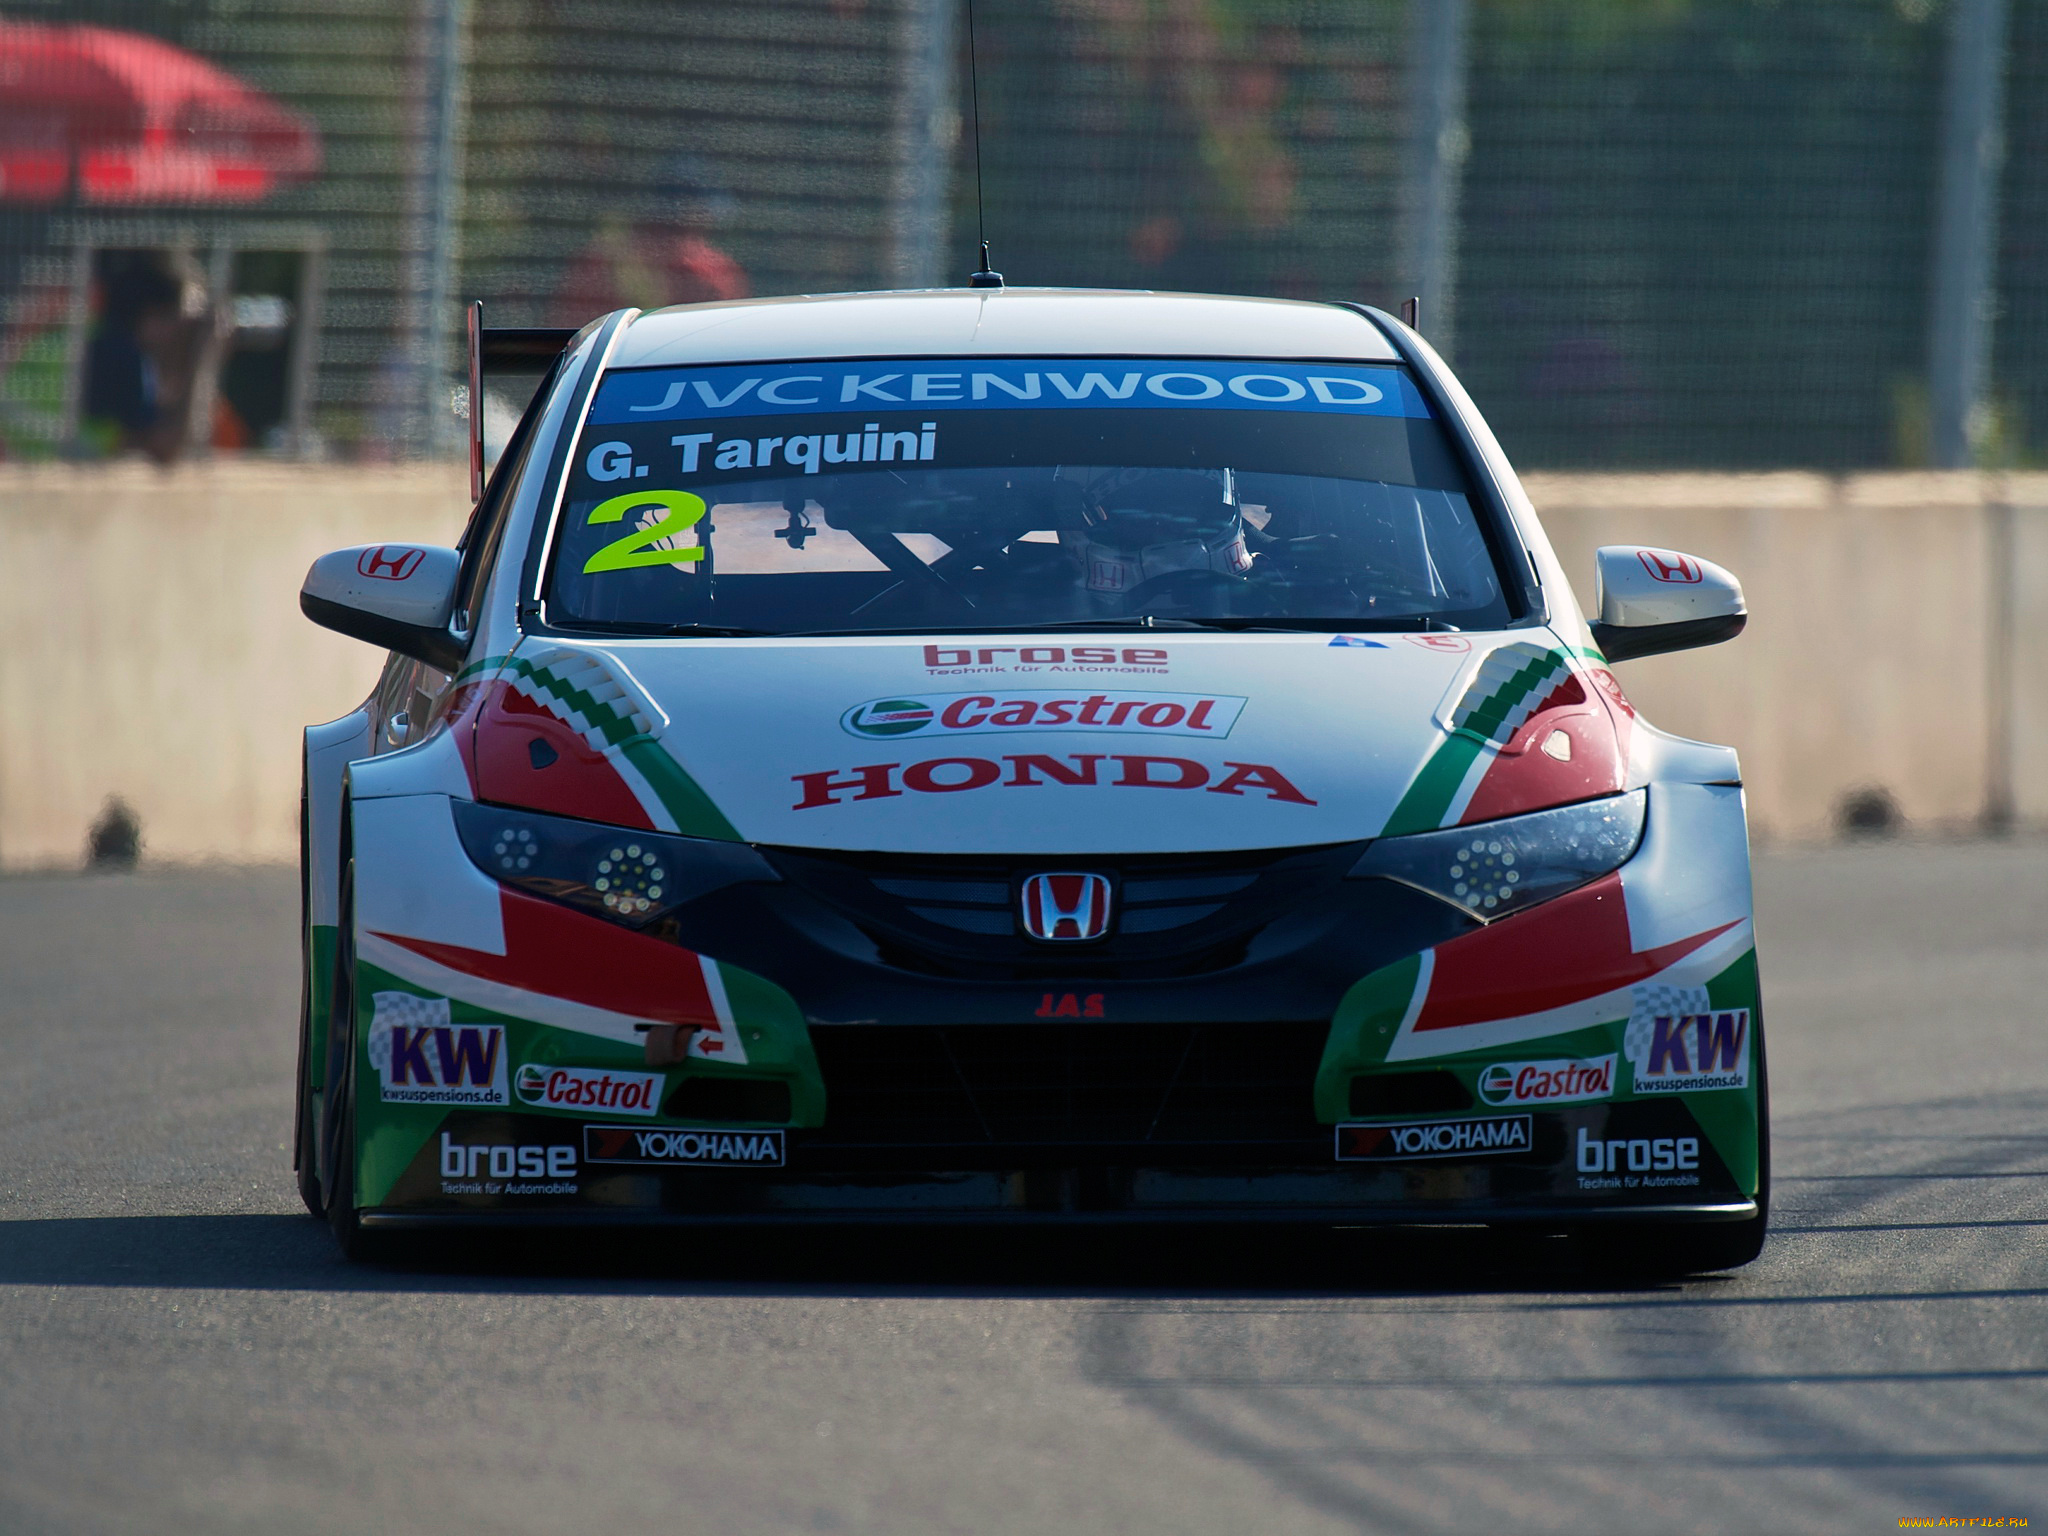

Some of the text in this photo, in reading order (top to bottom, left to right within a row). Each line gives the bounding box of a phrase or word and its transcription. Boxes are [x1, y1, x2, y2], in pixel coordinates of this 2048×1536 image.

[585, 422, 937, 482] G. Tarquini
[583, 489, 706, 574] 2
[923, 645, 1168, 667] brose
[925, 664, 1169, 676] Technik für Automobile
[940, 695, 1212, 731] Castrol
[791, 754, 1318, 811] HONDA
[1035, 993, 1105, 1018] JAS
[391, 1026, 501, 1088] KW
[1646, 1011, 1747, 1076] KW
[382, 1086, 502, 1104] kwsuspensions.de
[546, 1070, 654, 1111] Castrol
[1515, 1062, 1611, 1101] Castrol
[1634, 1074, 1744, 1092] kwsuspensions.de
[441, 1131, 577, 1178] brose
[636, 1132, 777, 1162] YOKOHAMA
[1391, 1120, 1527, 1154] YOKOHAMA
[1577, 1126, 1699, 1172] brose
[441, 1182, 578, 1194] Technik für Automobile
[1578, 1174, 1699, 1189] Technik für Automobile
